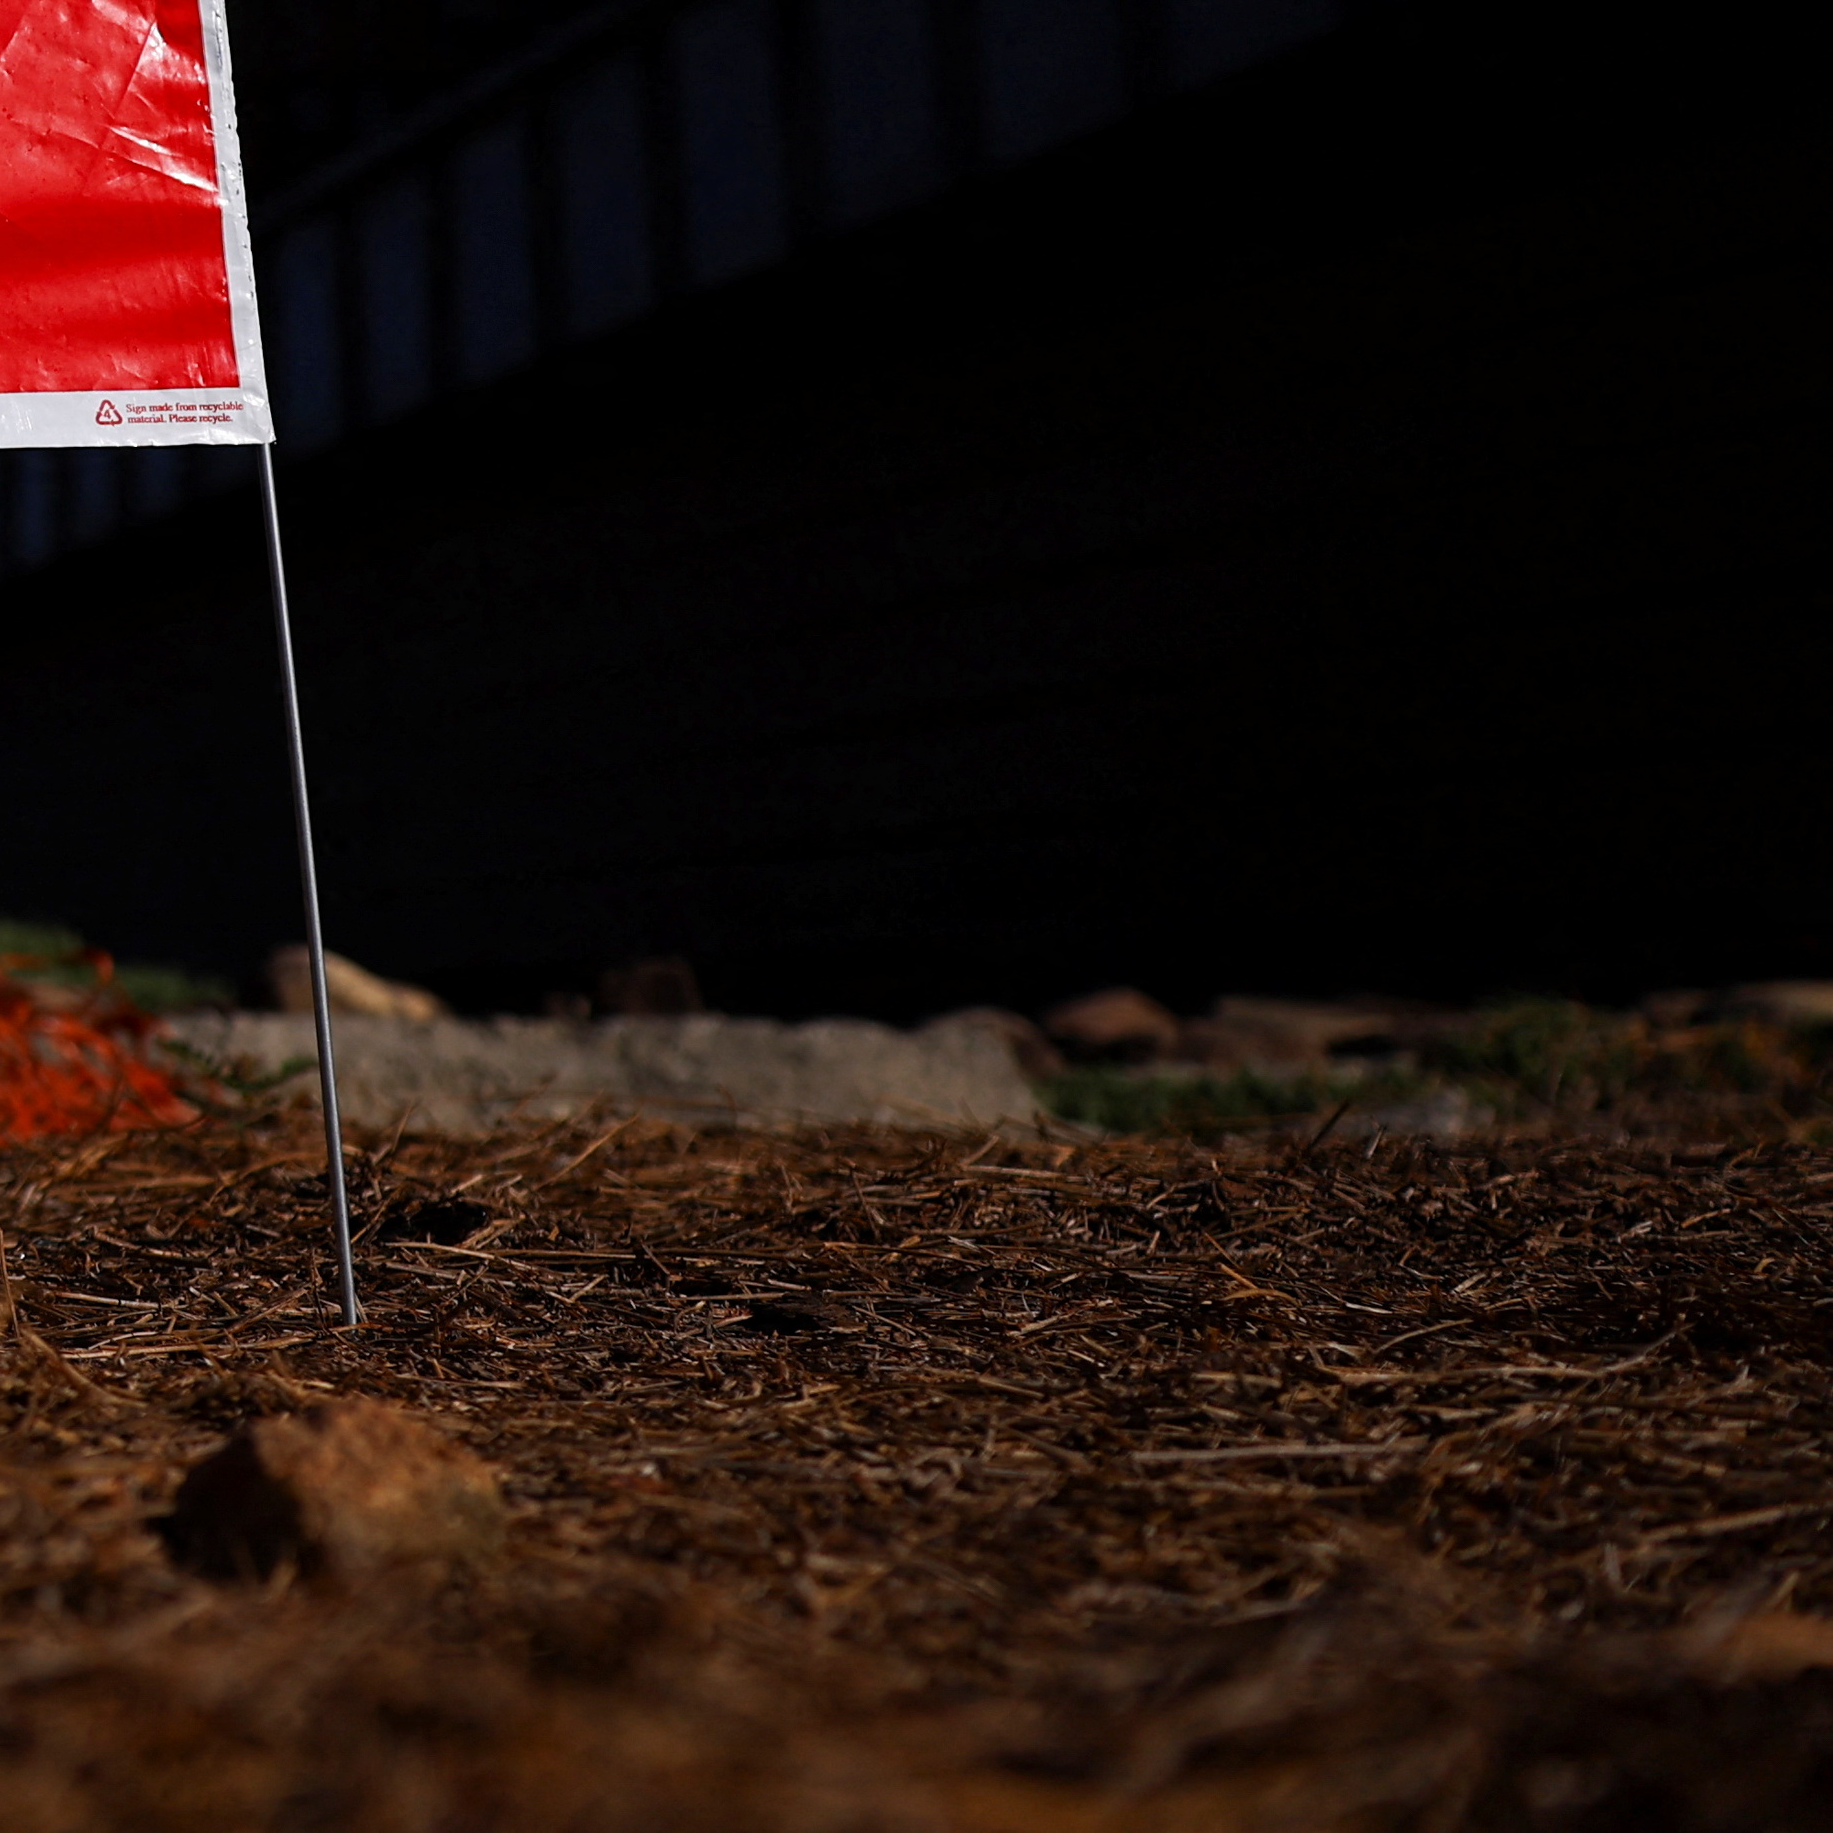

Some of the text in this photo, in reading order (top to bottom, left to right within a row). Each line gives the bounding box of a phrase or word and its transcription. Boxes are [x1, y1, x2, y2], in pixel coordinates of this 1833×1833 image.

[126, 401, 244, 414] Sign made from recyclable
[128, 413, 233, 424] material. Please recycle.
